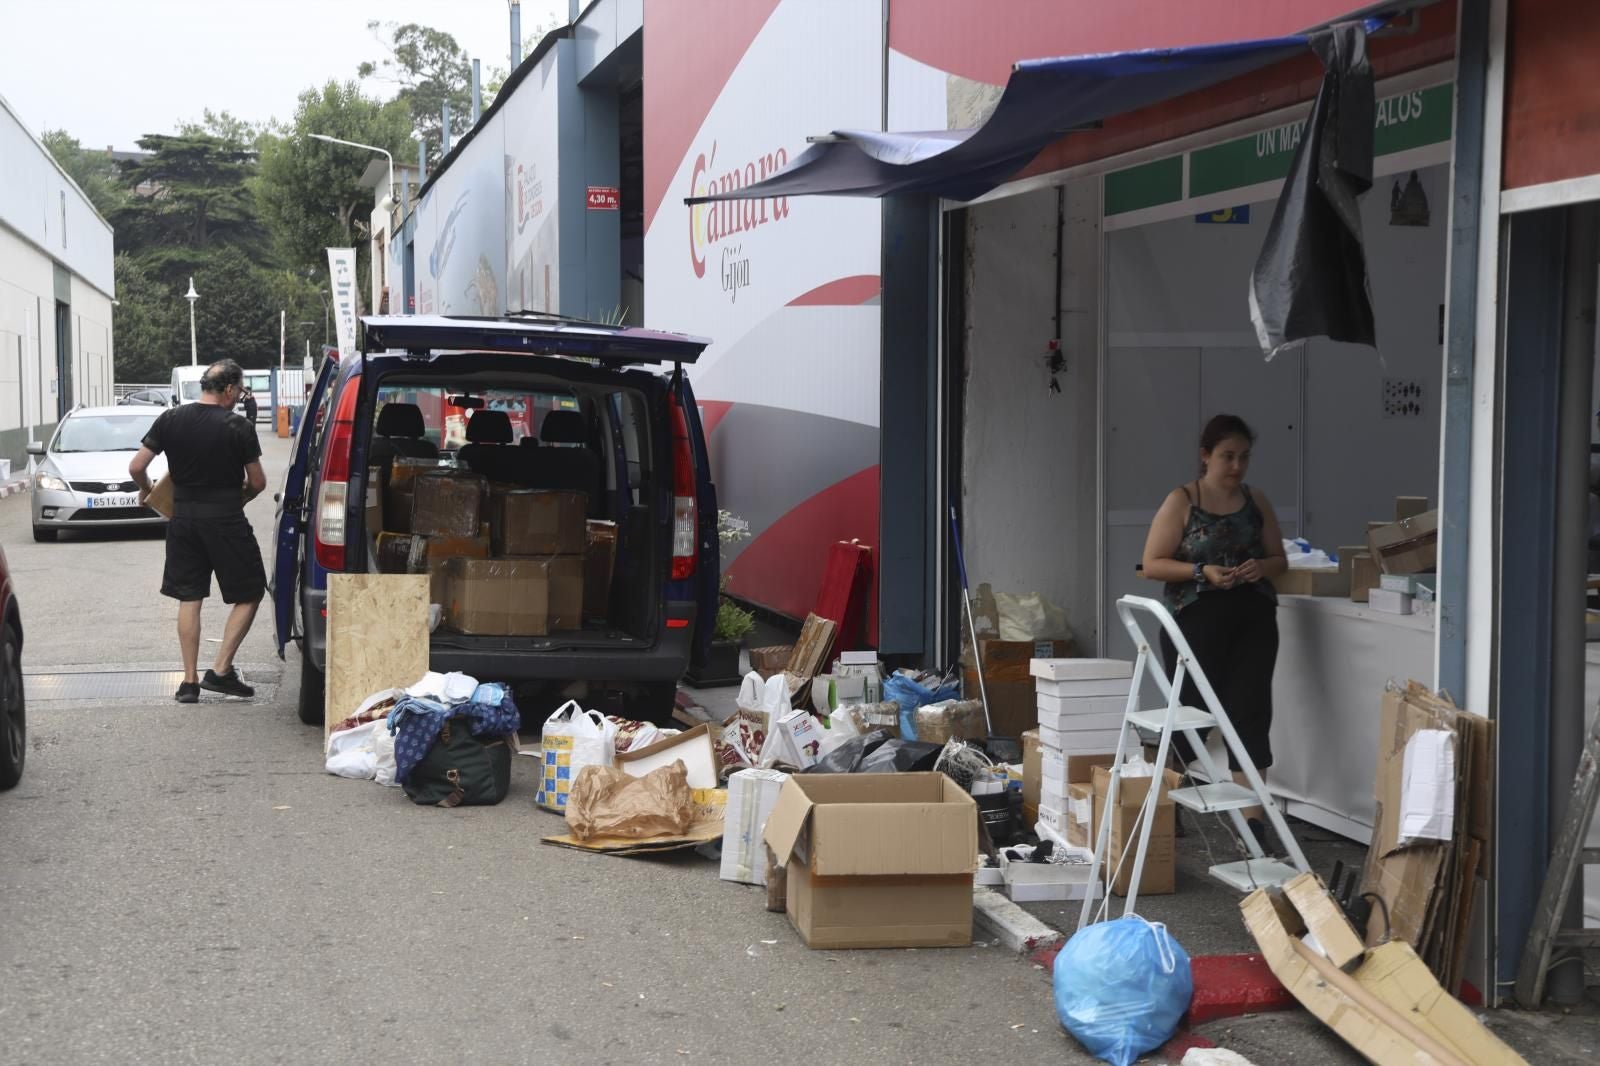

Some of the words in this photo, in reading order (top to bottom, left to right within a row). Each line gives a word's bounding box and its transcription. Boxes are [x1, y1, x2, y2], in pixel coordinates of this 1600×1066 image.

[1256, 129, 1275, 158] UN
[1375, 90, 1422, 128] ALOS
[589, 194, 606, 205] 4,30
[607, 196, 617, 204] m.
[690, 139, 789, 279] Cámara
[721, 243, 750, 304] Gijón
[94, 497, 116, 507] 6514
[119, 497, 137, 506] GXK
